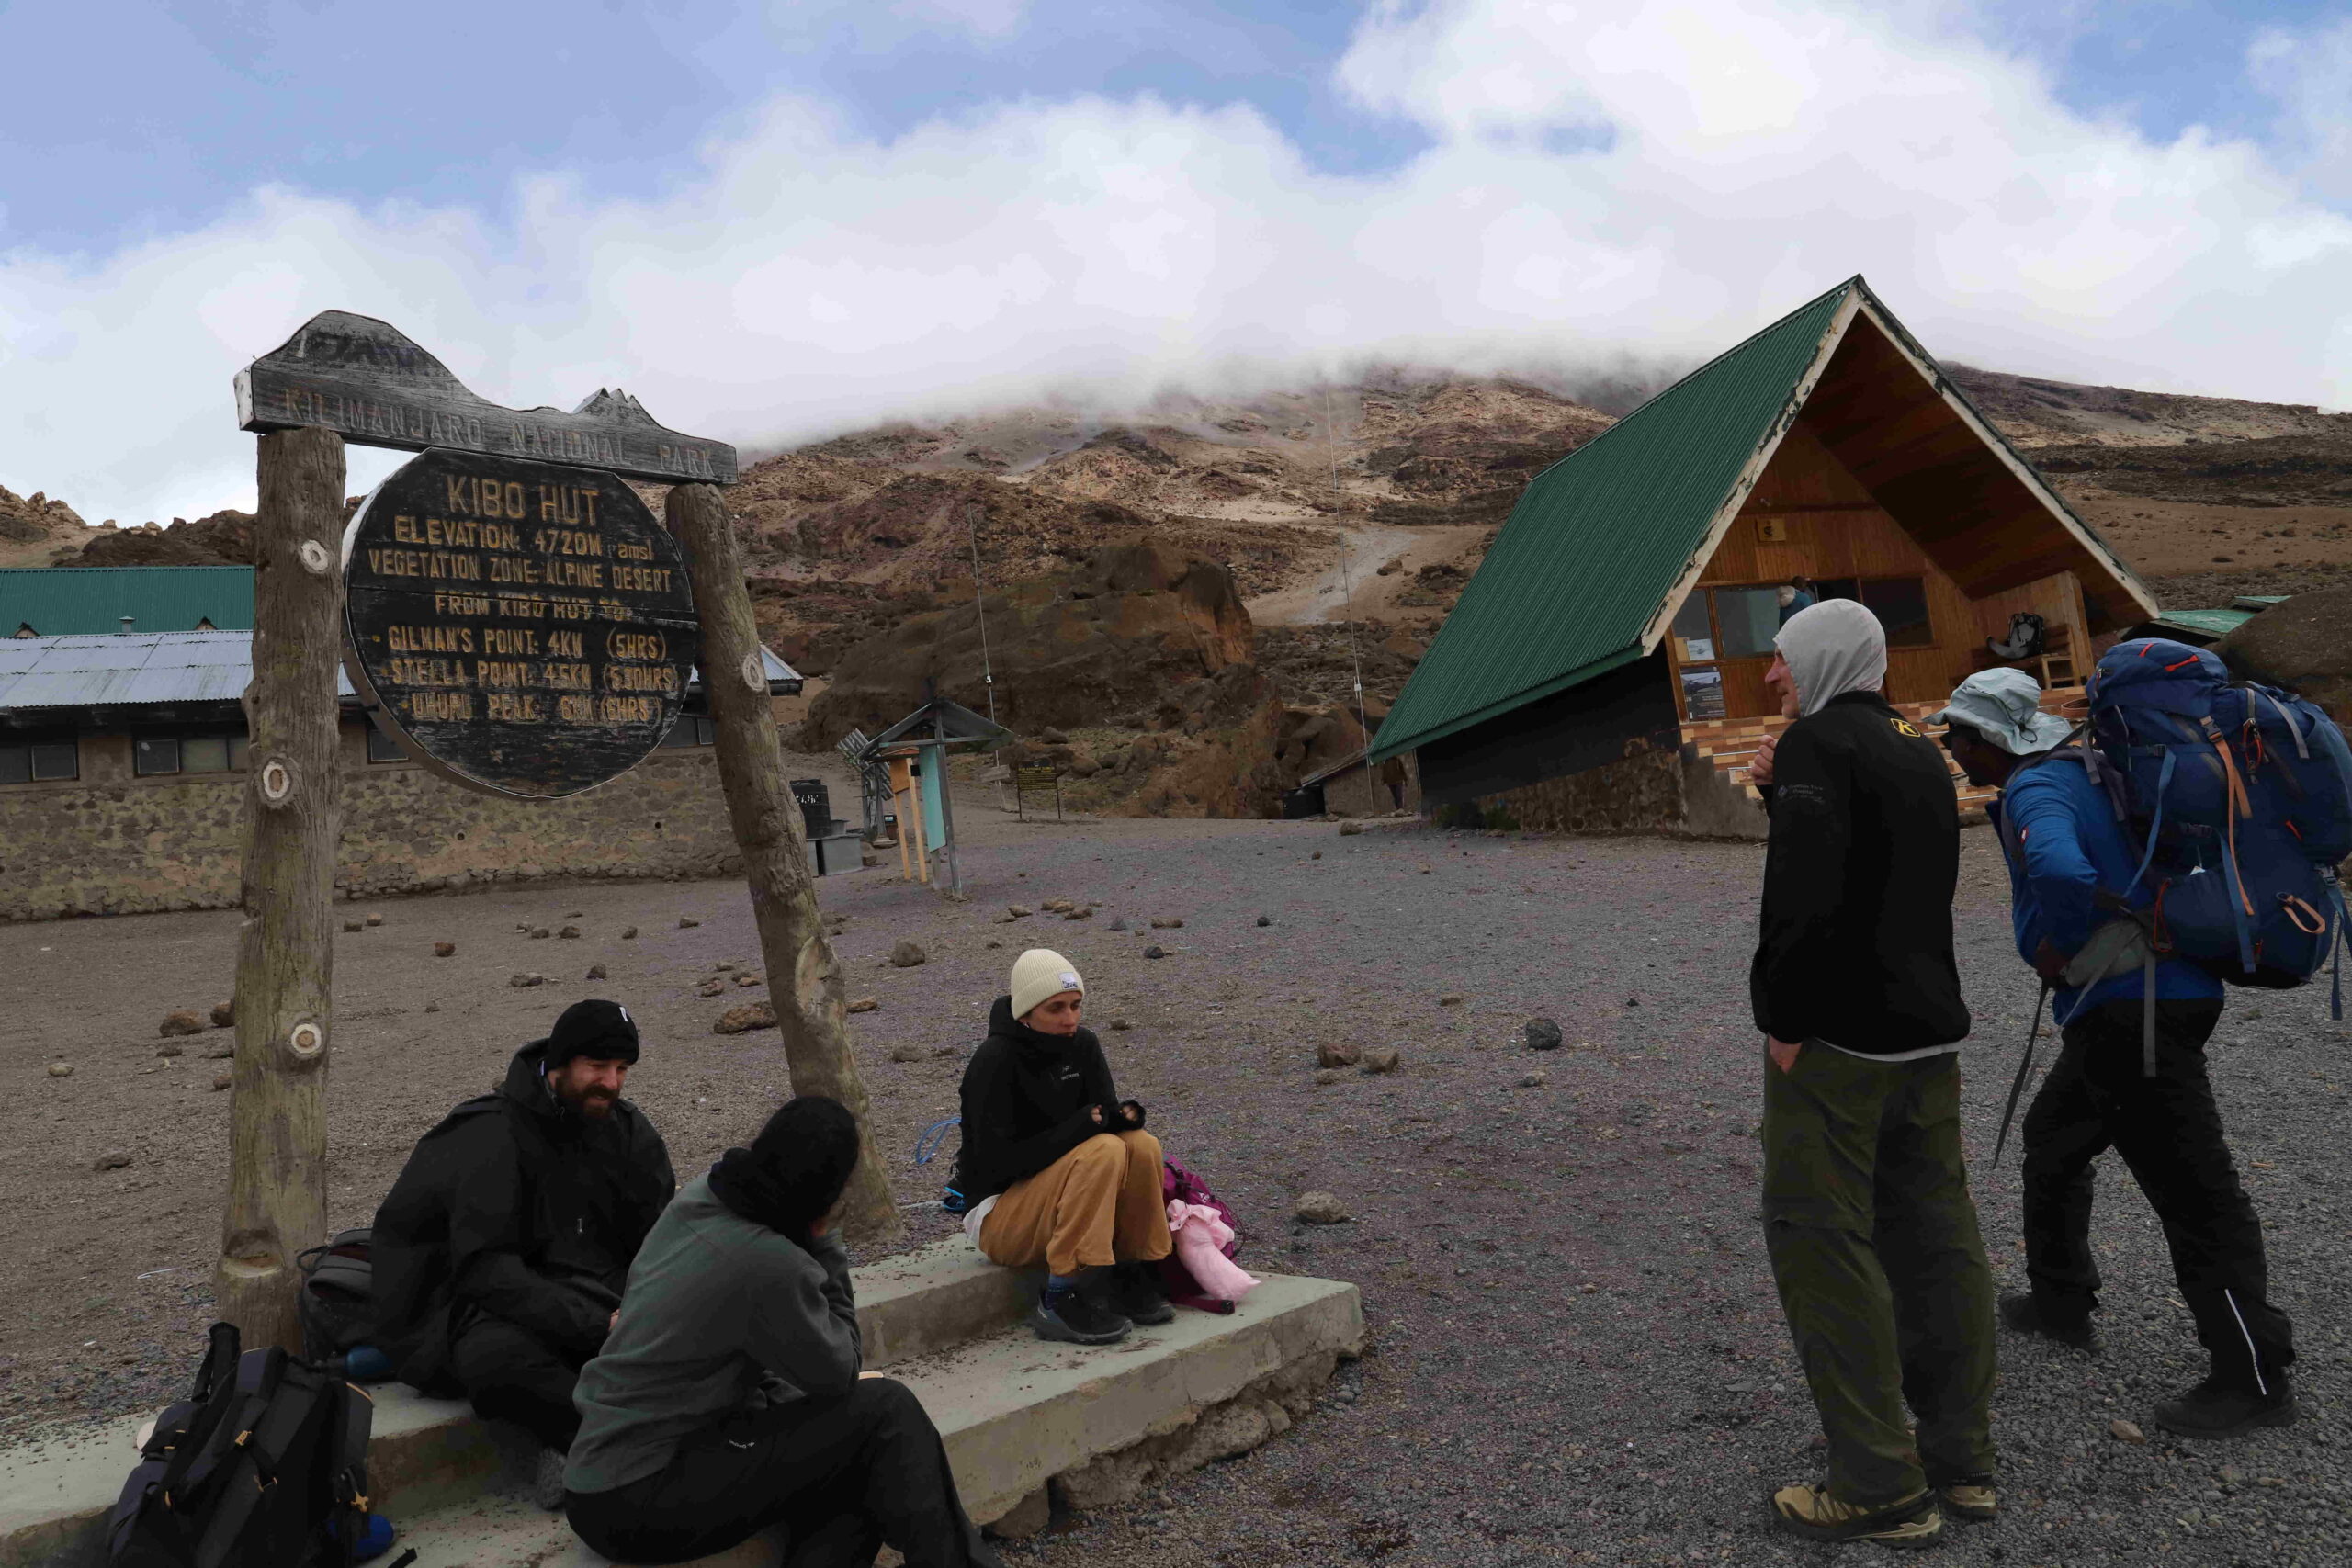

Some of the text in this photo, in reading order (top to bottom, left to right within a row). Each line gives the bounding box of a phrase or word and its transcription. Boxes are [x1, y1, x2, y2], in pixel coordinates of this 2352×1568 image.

[284, 388, 715, 478] KILIMANJARO NATIONAL PARK
[447, 473, 599, 526] KIBO HUT
[534, 528, 603, 557] 4720M
[617, 542, 652, 561] amsl
[368, 548, 481, 581] VEGETATION
[545, 559, 604, 588] ALPINE
[612, 565, 672, 592] DESERT
[434, 589, 490, 616] FROM
[497, 591, 549, 618] KIBO
[553, 594, 594, 620] HUT
[388, 625, 476, 654] GILMAN'S
[547, 630, 583, 659] 4KM
[606, 626, 667, 662] (5HRS)
[391, 658, 467, 686] STELLA
[411, 692, 474, 721] UHURU
[559, 695, 595, 722] 6KM
